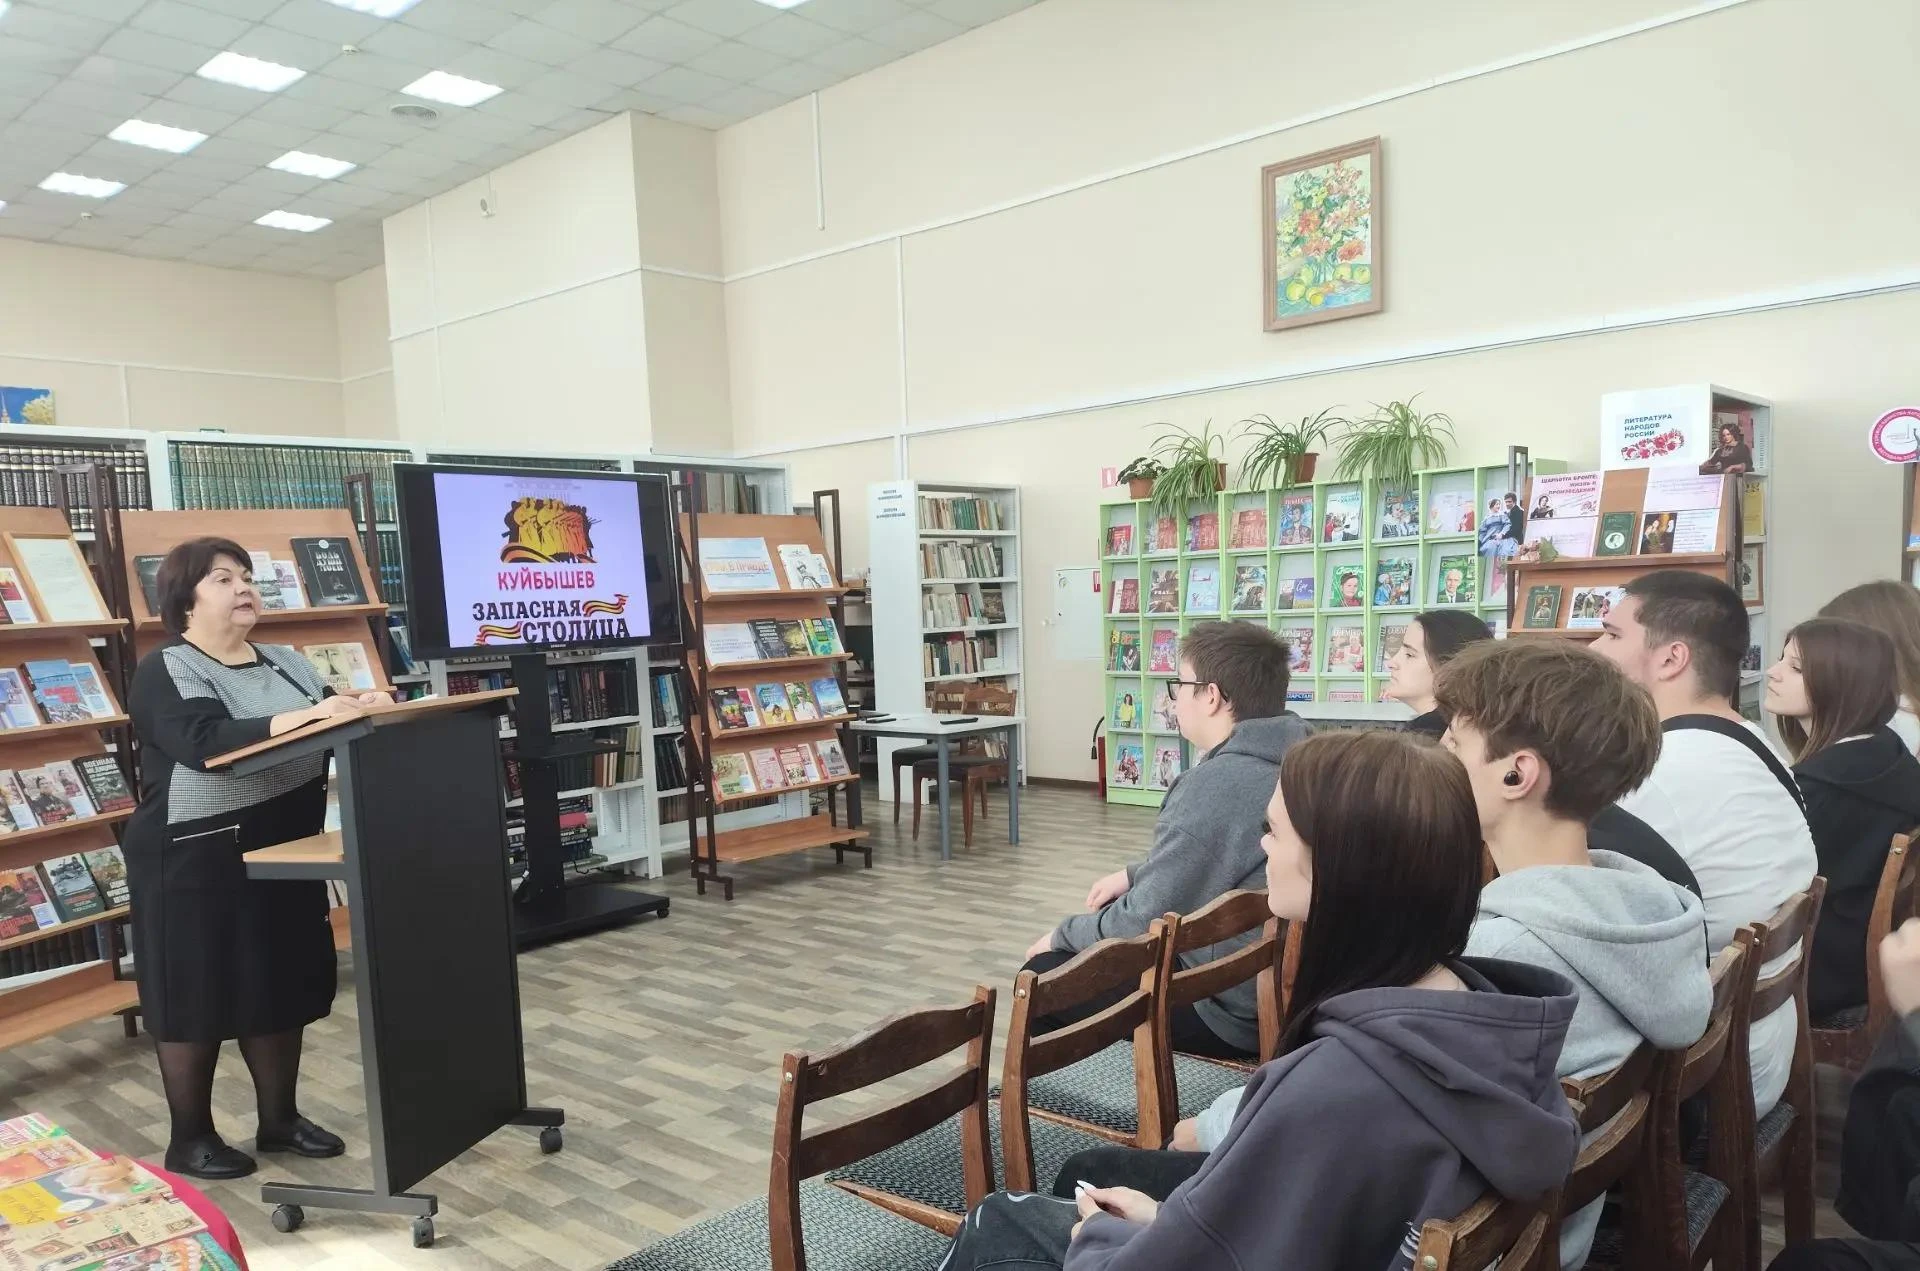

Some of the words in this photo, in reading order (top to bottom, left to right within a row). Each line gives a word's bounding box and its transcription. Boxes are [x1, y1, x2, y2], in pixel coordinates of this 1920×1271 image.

[1624, 414, 1673, 425] ЛИТЕРАТУРА
[1624, 423, 1660, 431] НАРОДОВ
[498, 567, 595, 590] КУЙБЫШЕВ
[472, 600, 582, 621] ЗАПАСНАЯ
[522, 618, 630, 644] СТОЛИЦА
